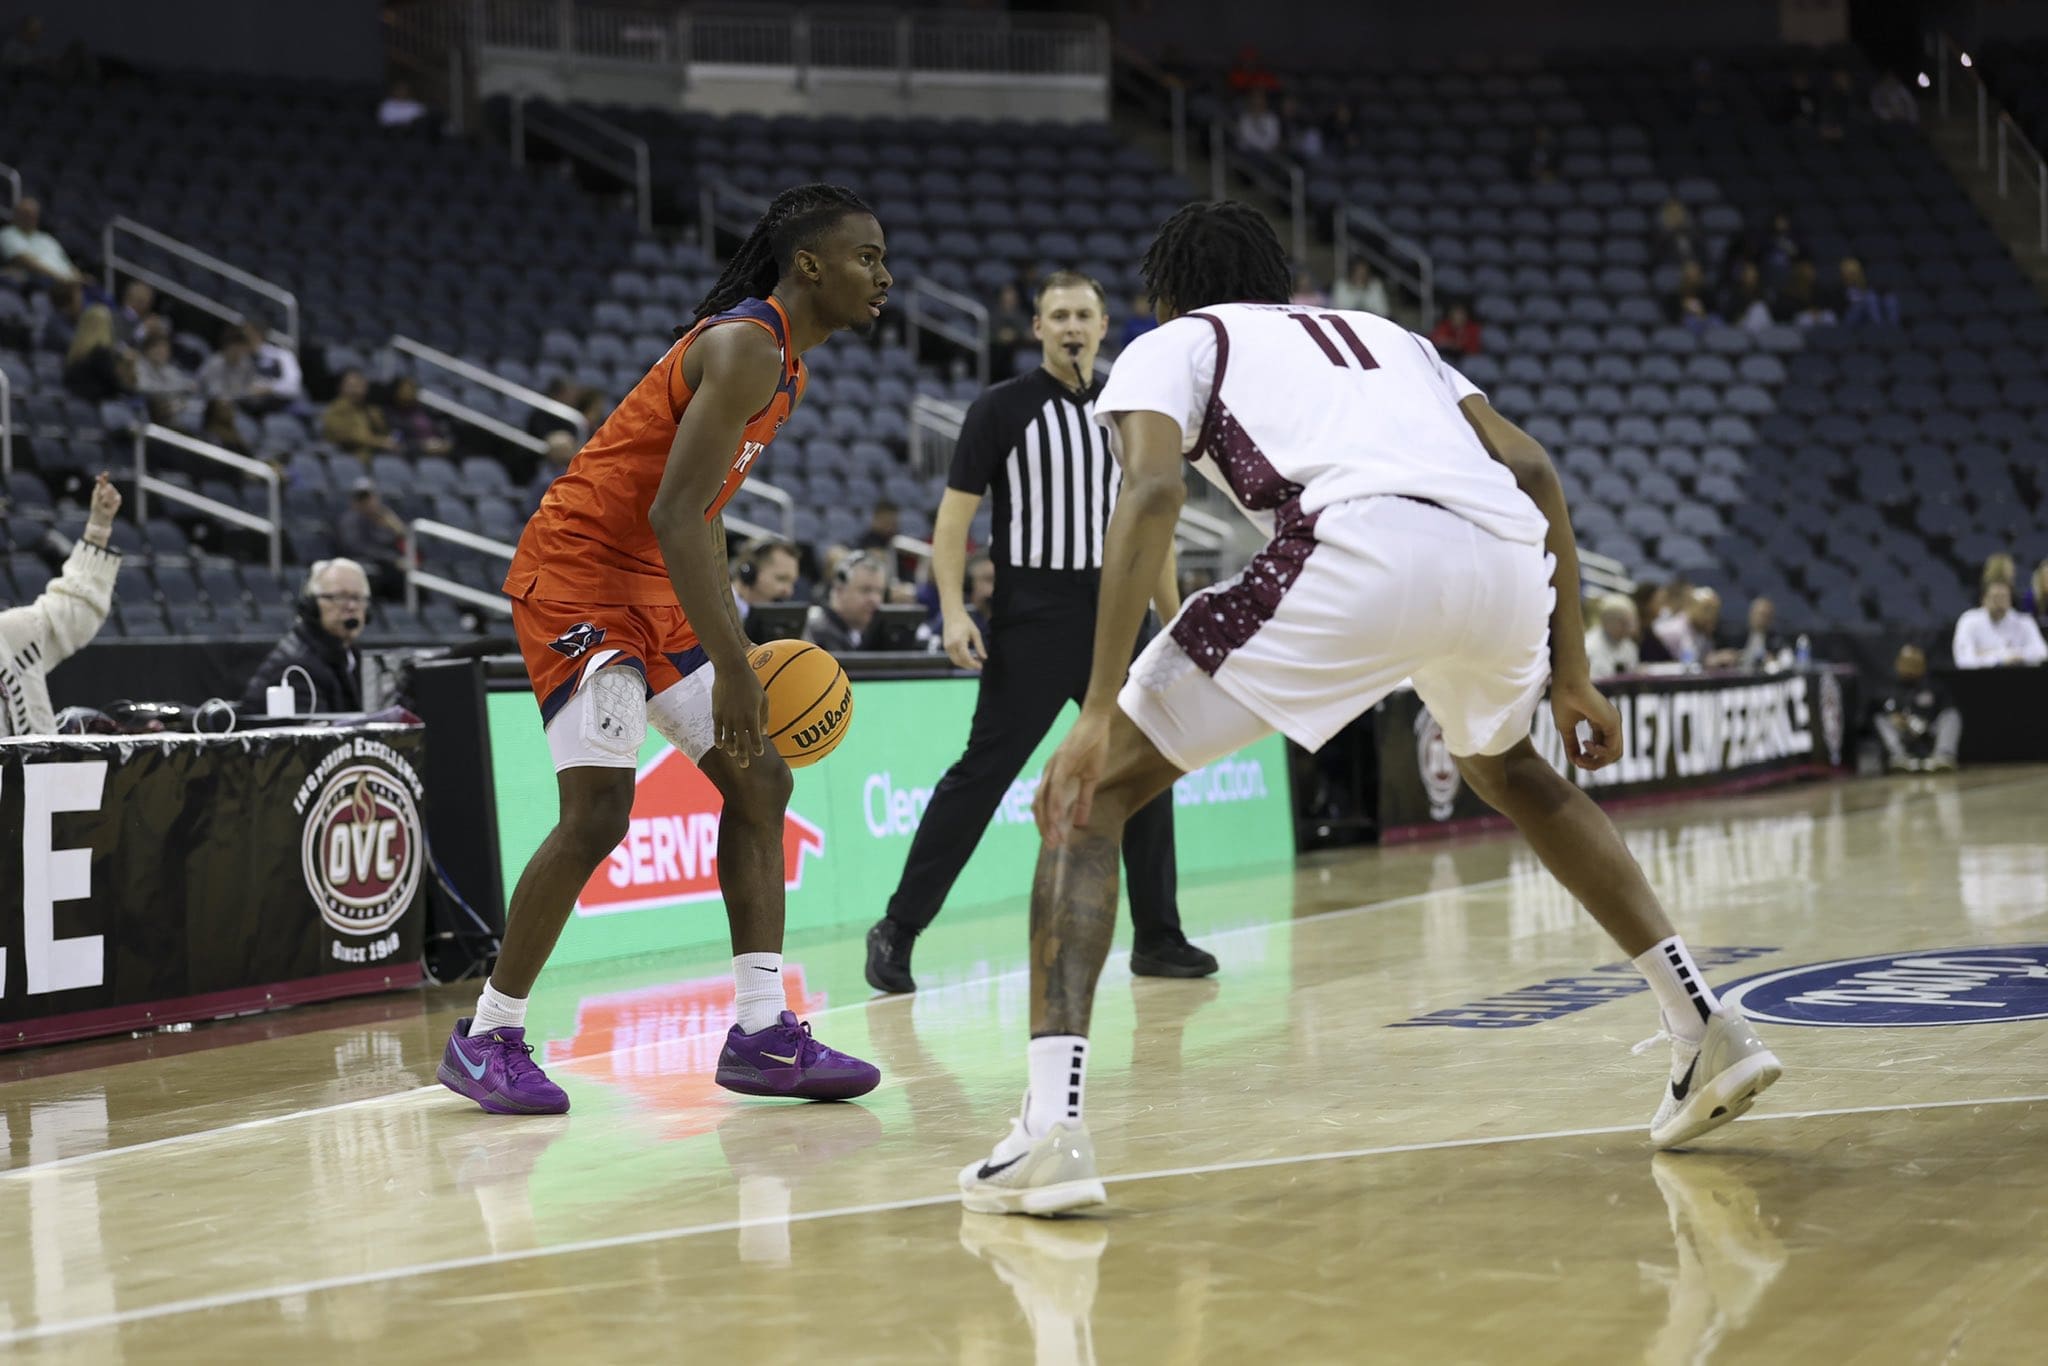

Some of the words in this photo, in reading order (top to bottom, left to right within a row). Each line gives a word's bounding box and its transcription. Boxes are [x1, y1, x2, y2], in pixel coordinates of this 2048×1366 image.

[1288, 313, 1381, 370] 11
[791, 686, 852, 749] Wilson
[329, 818, 398, 886] OVC
[607, 811, 721, 889] SERVP
